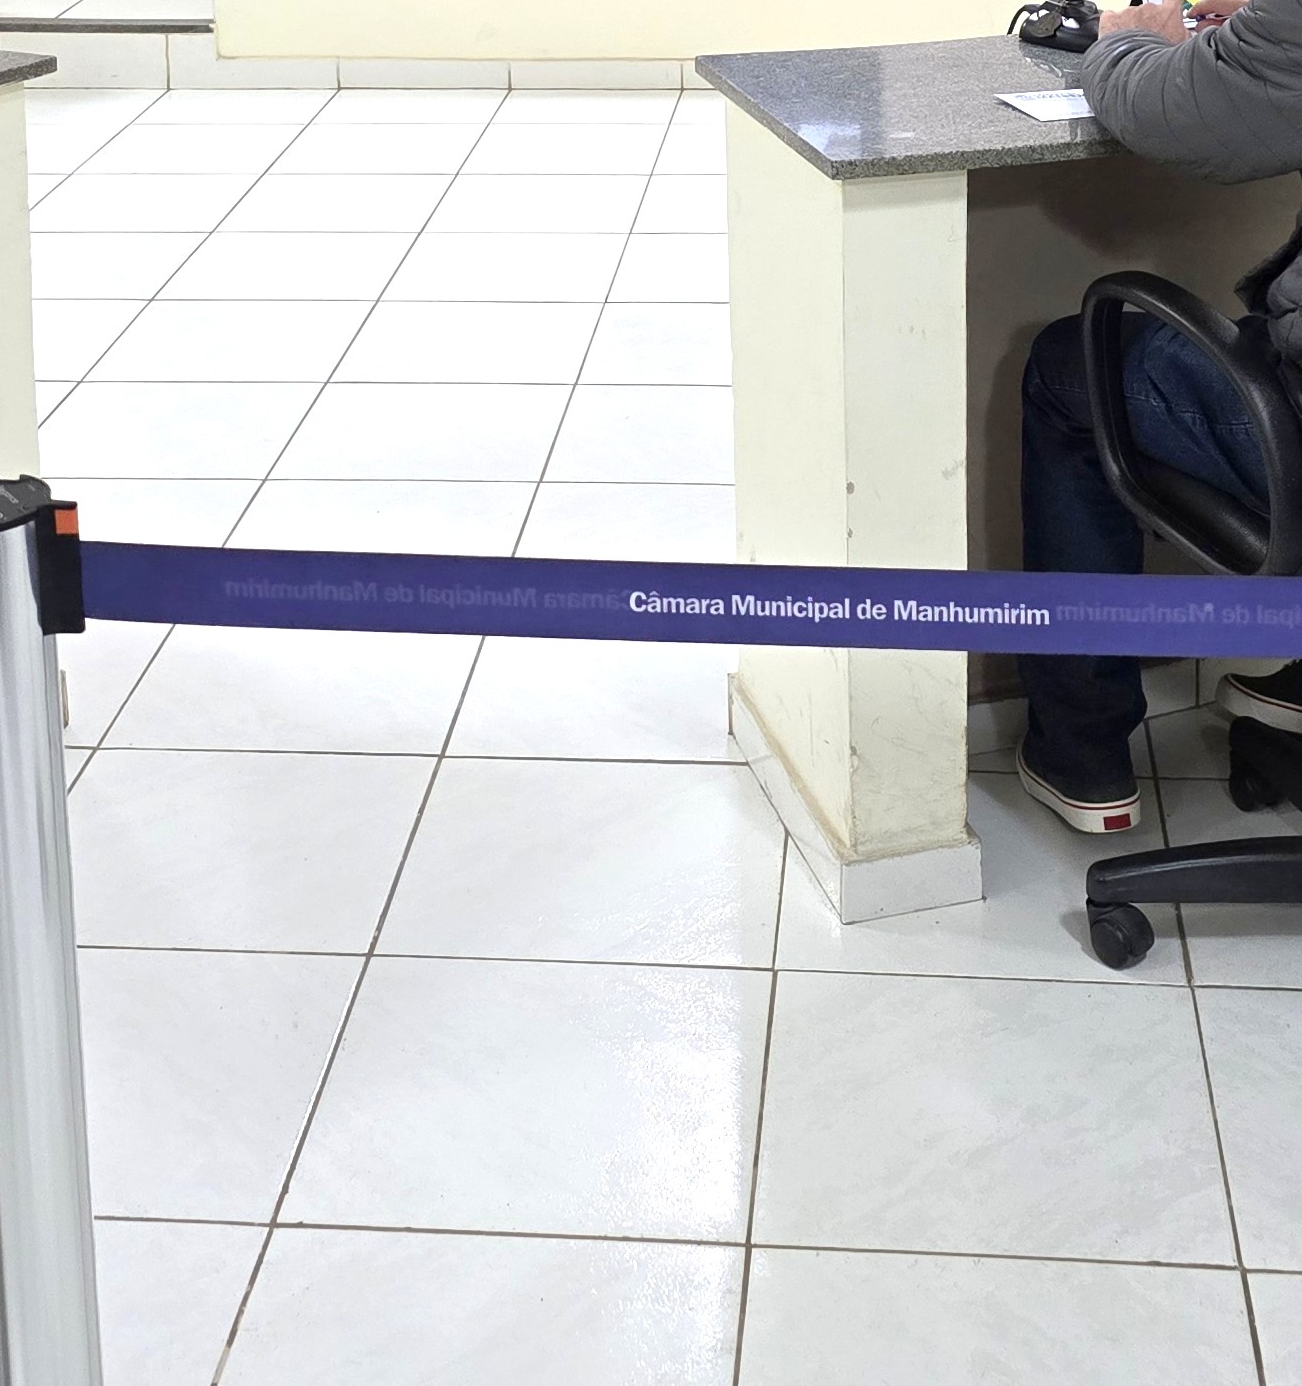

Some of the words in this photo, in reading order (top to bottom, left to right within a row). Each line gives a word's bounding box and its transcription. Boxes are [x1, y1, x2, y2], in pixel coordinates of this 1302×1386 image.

[629, 591, 726, 615] Câmara
[731, 594, 851, 623] Municipal
[856, 598, 888, 621] de
[893, 599, 1051, 626] Manhumirim
